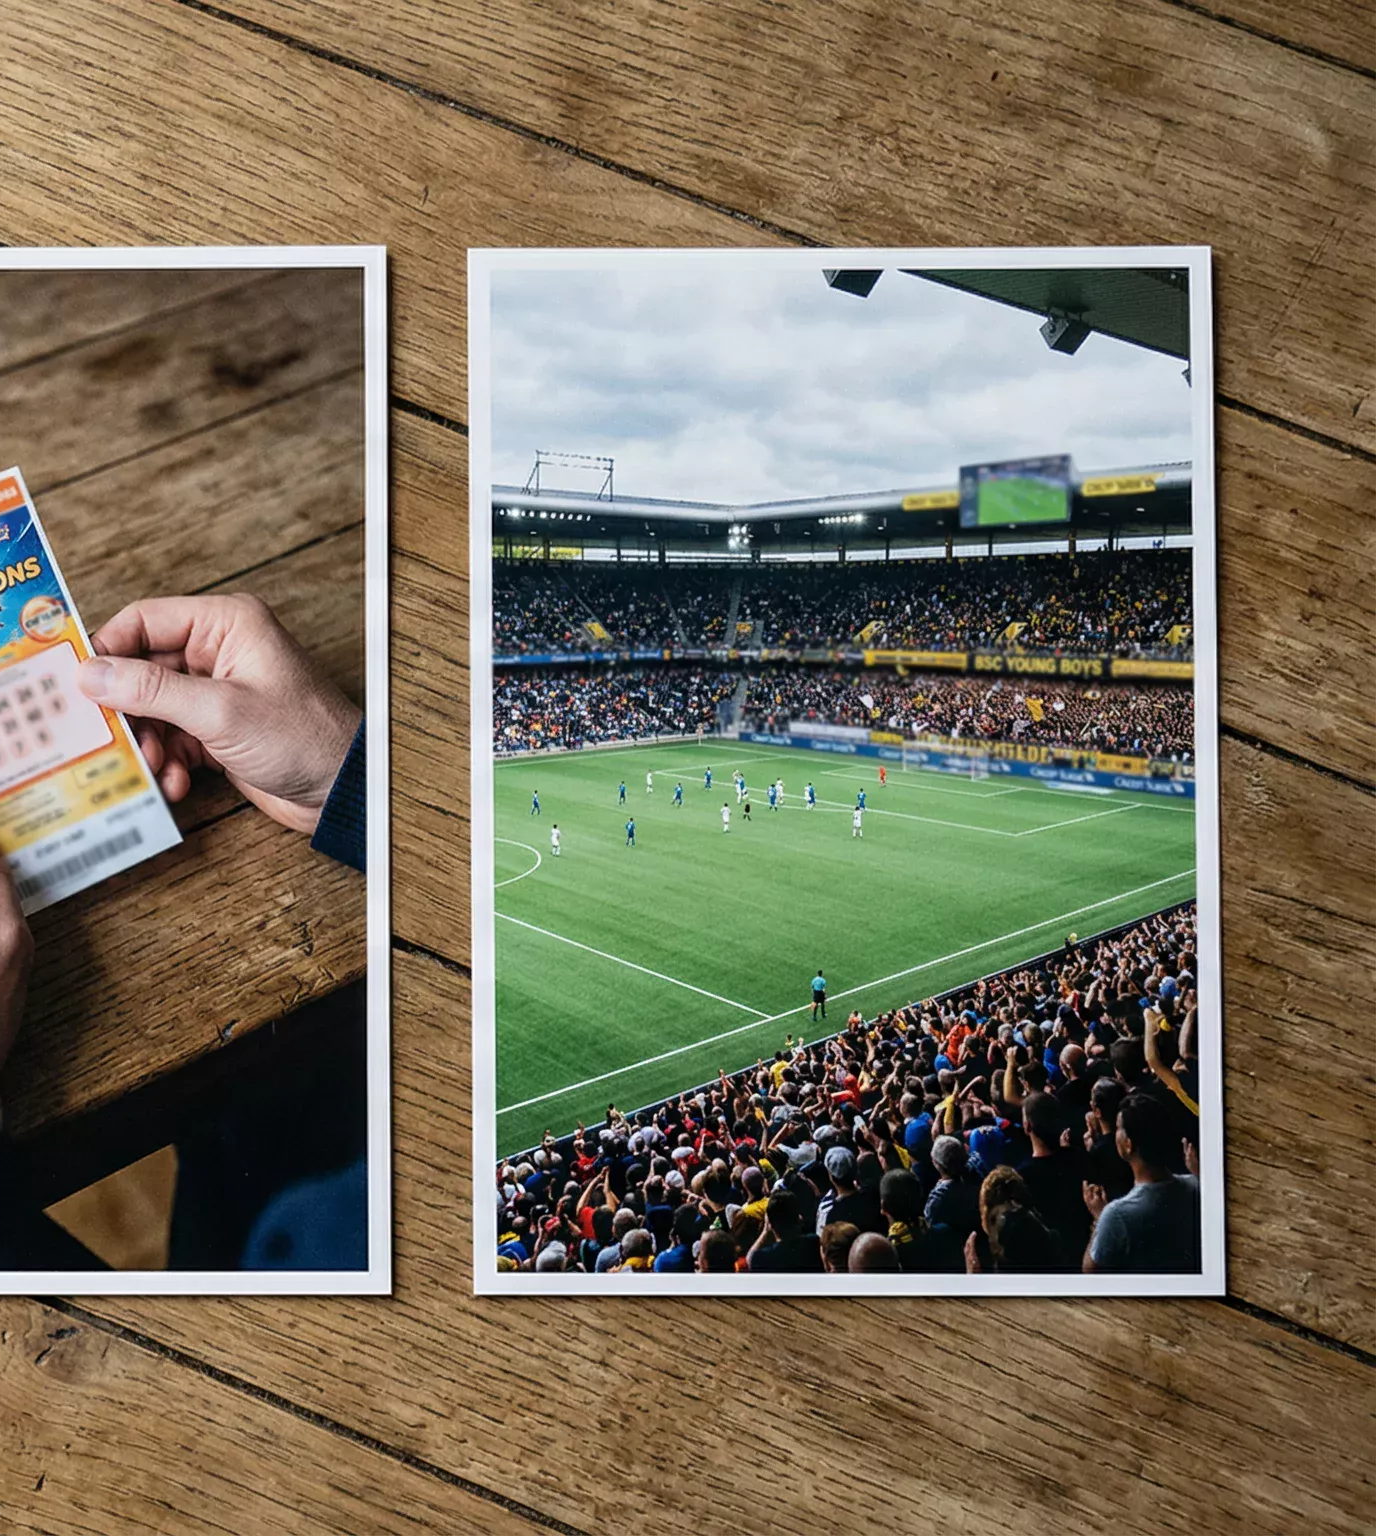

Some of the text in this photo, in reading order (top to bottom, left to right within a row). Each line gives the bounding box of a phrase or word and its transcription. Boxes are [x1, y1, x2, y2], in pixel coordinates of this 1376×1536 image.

[974, 656, 1003, 671] BSC
[1006, 657, 1056, 674] YOUNG
[1061, 659, 1103, 676] BOYS
